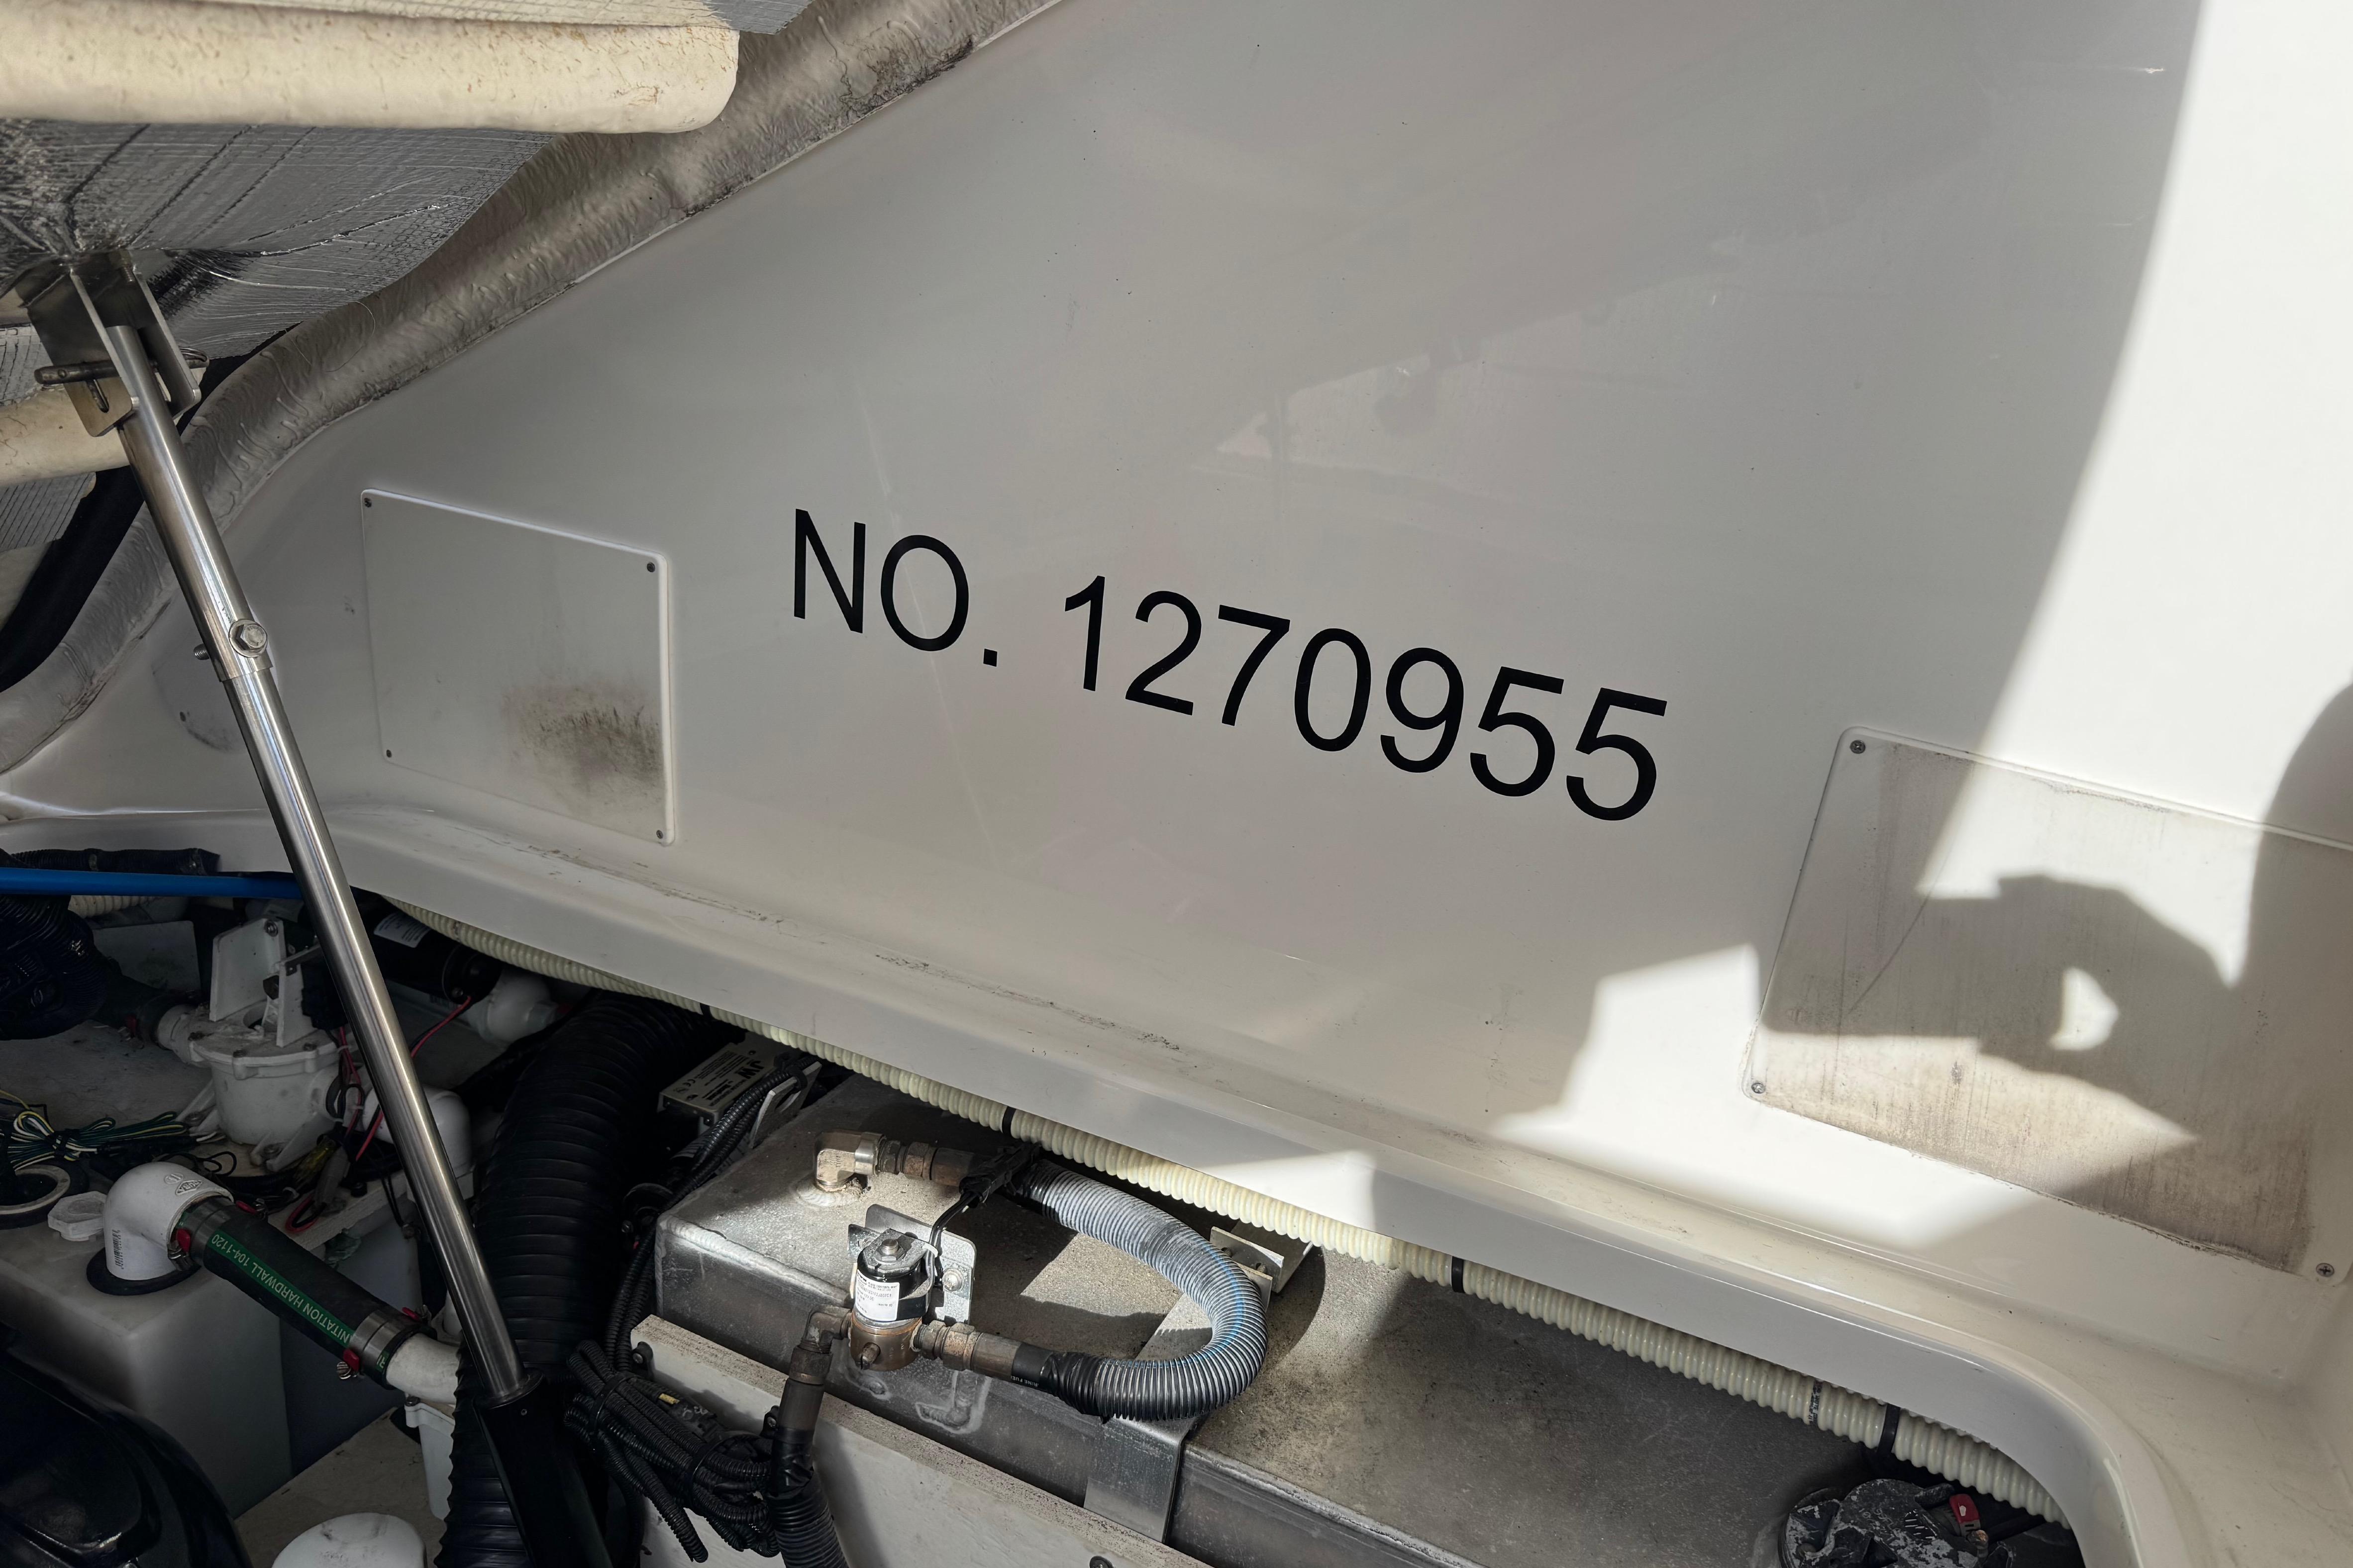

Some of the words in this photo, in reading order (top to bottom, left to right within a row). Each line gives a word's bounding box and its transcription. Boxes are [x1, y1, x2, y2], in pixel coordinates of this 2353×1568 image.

[793, 508, 998, 667] NO.
[1064, 575, 1668, 821] 1270955
[211, 1234, 250, 1266] 104-1120
[251, 1262, 304, 1308] HARDWALL
